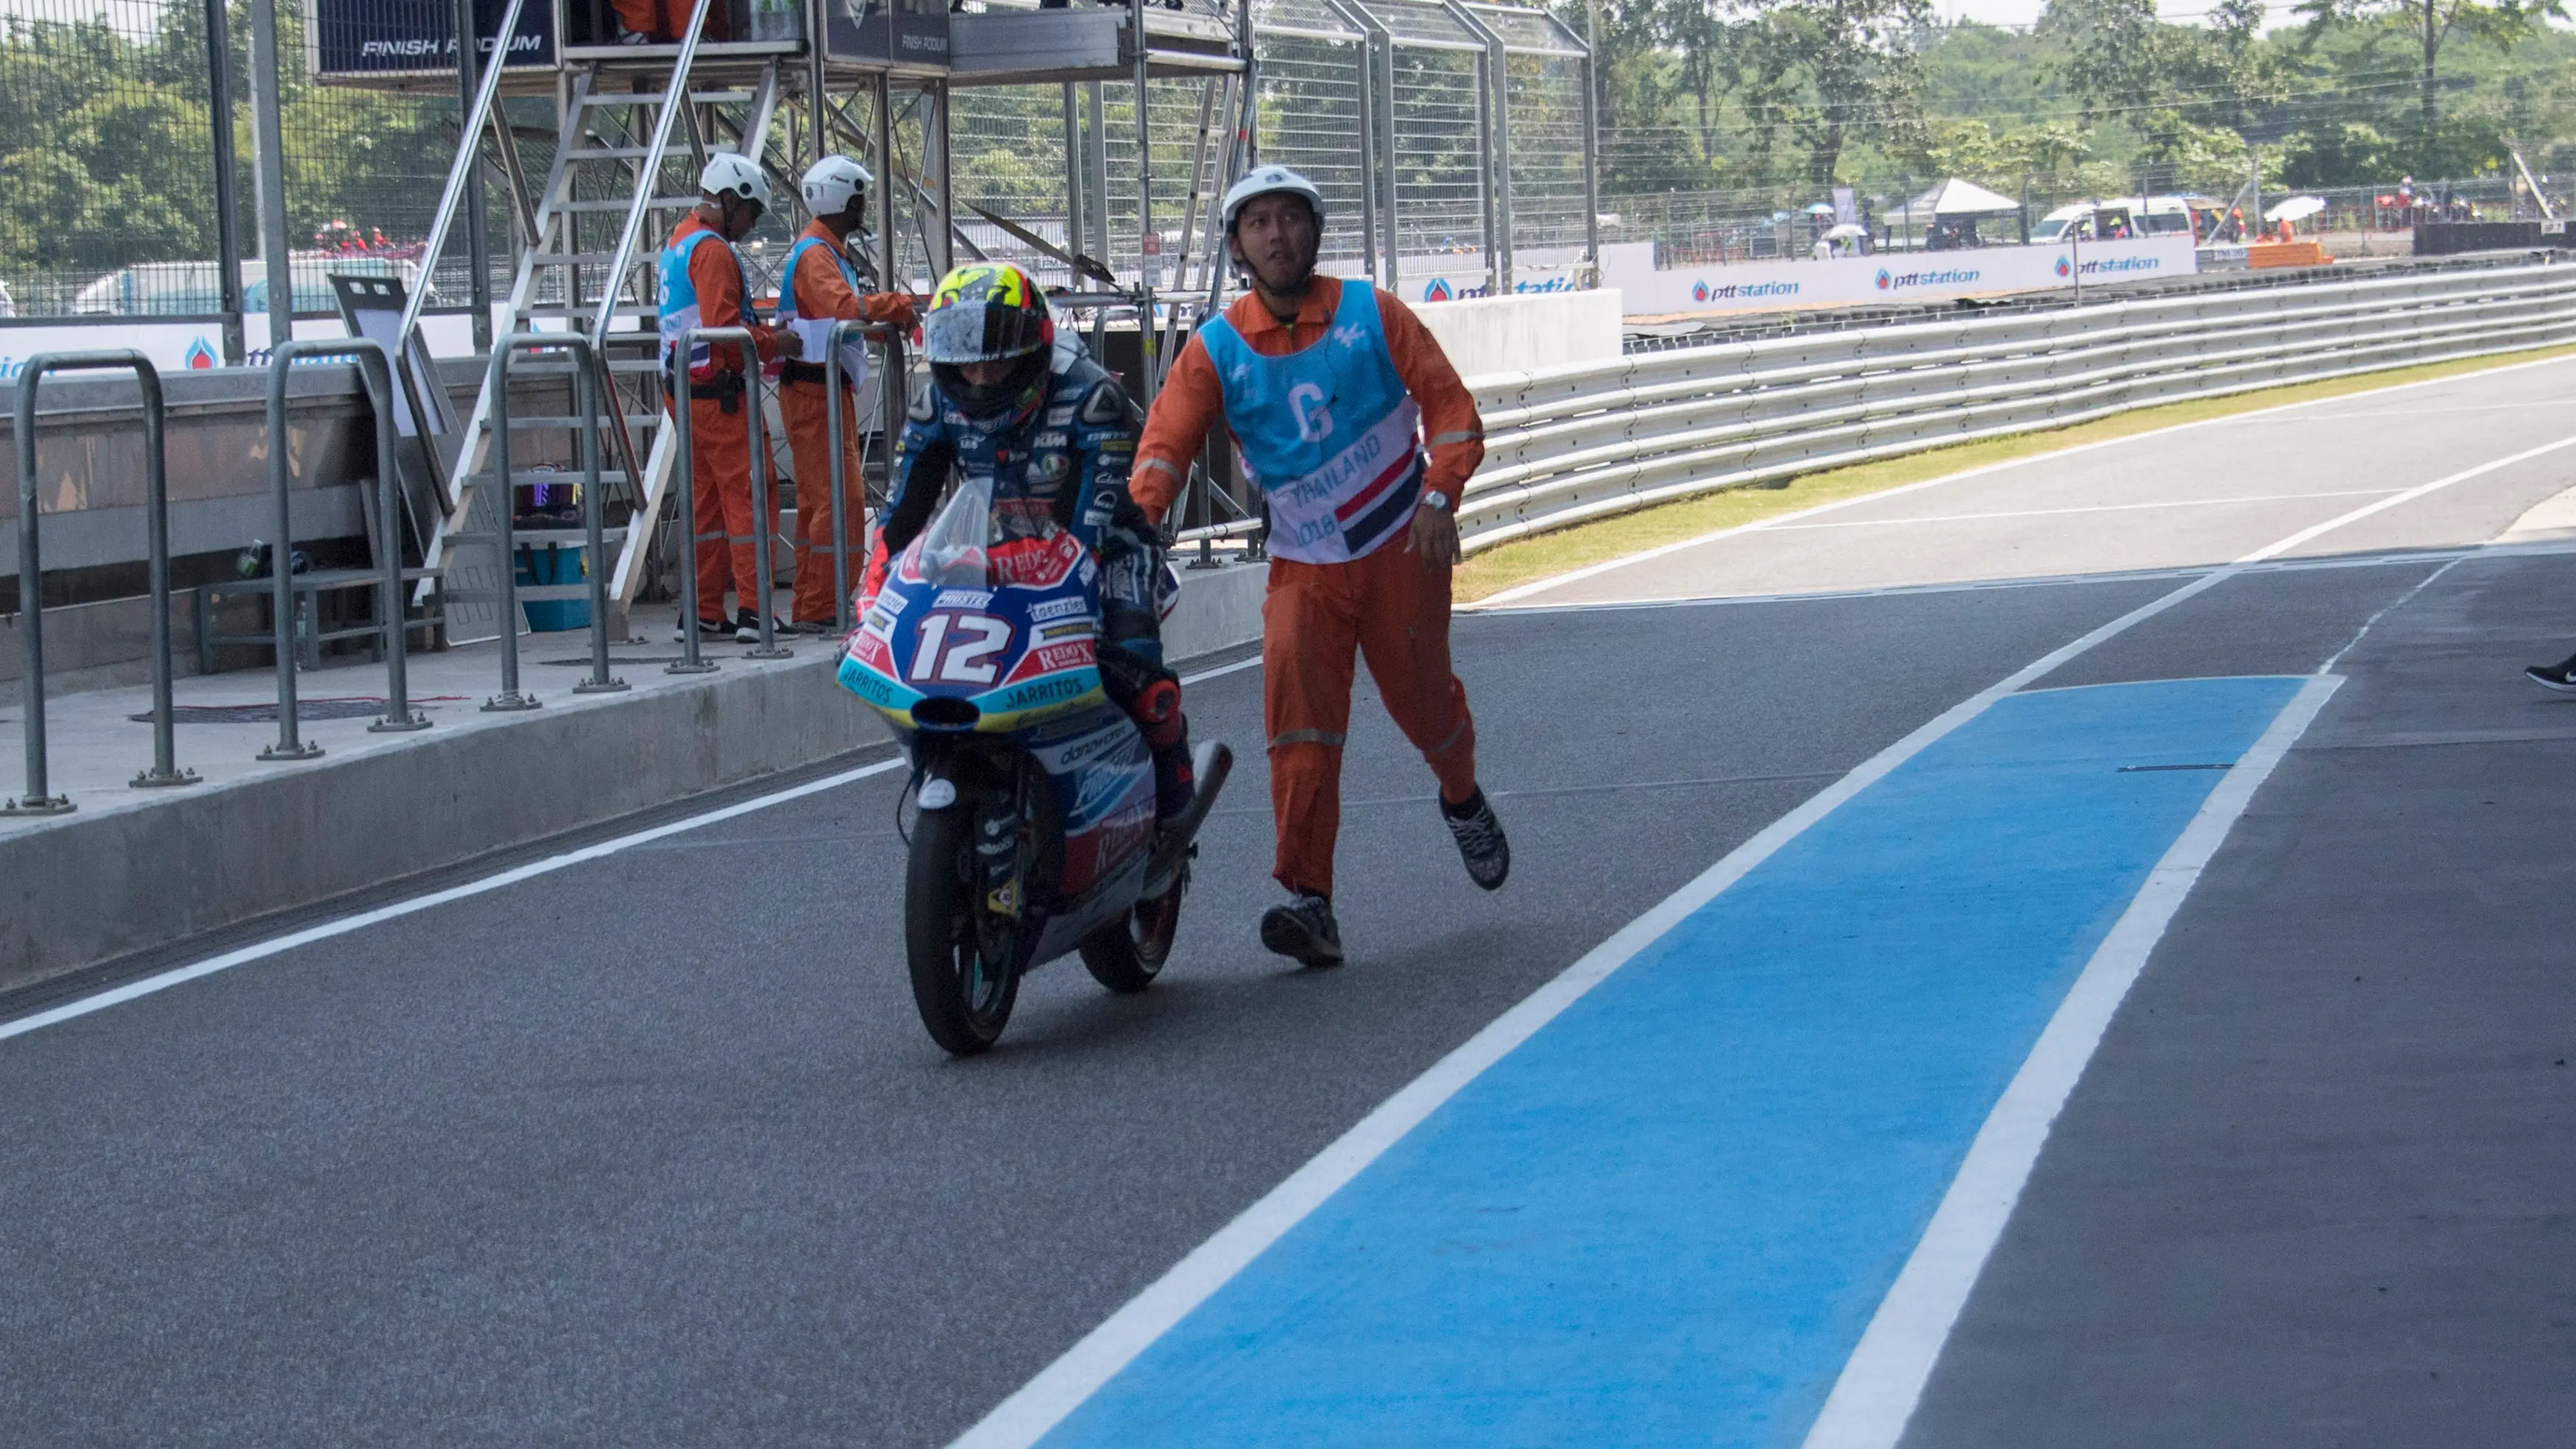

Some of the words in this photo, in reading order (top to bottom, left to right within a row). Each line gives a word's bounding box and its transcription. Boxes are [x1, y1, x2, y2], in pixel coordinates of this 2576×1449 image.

[361, 38, 440, 57] FINISH
[1288, 383, 1334, 443] G
[1291, 434, 1381, 509] THAILAND
[1299, 514, 1336, 547] 018
[909, 612, 1016, 686] 12
[843, 667, 893, 703] JARRITOS
[1005, 677, 1083, 709] JARRITOS
